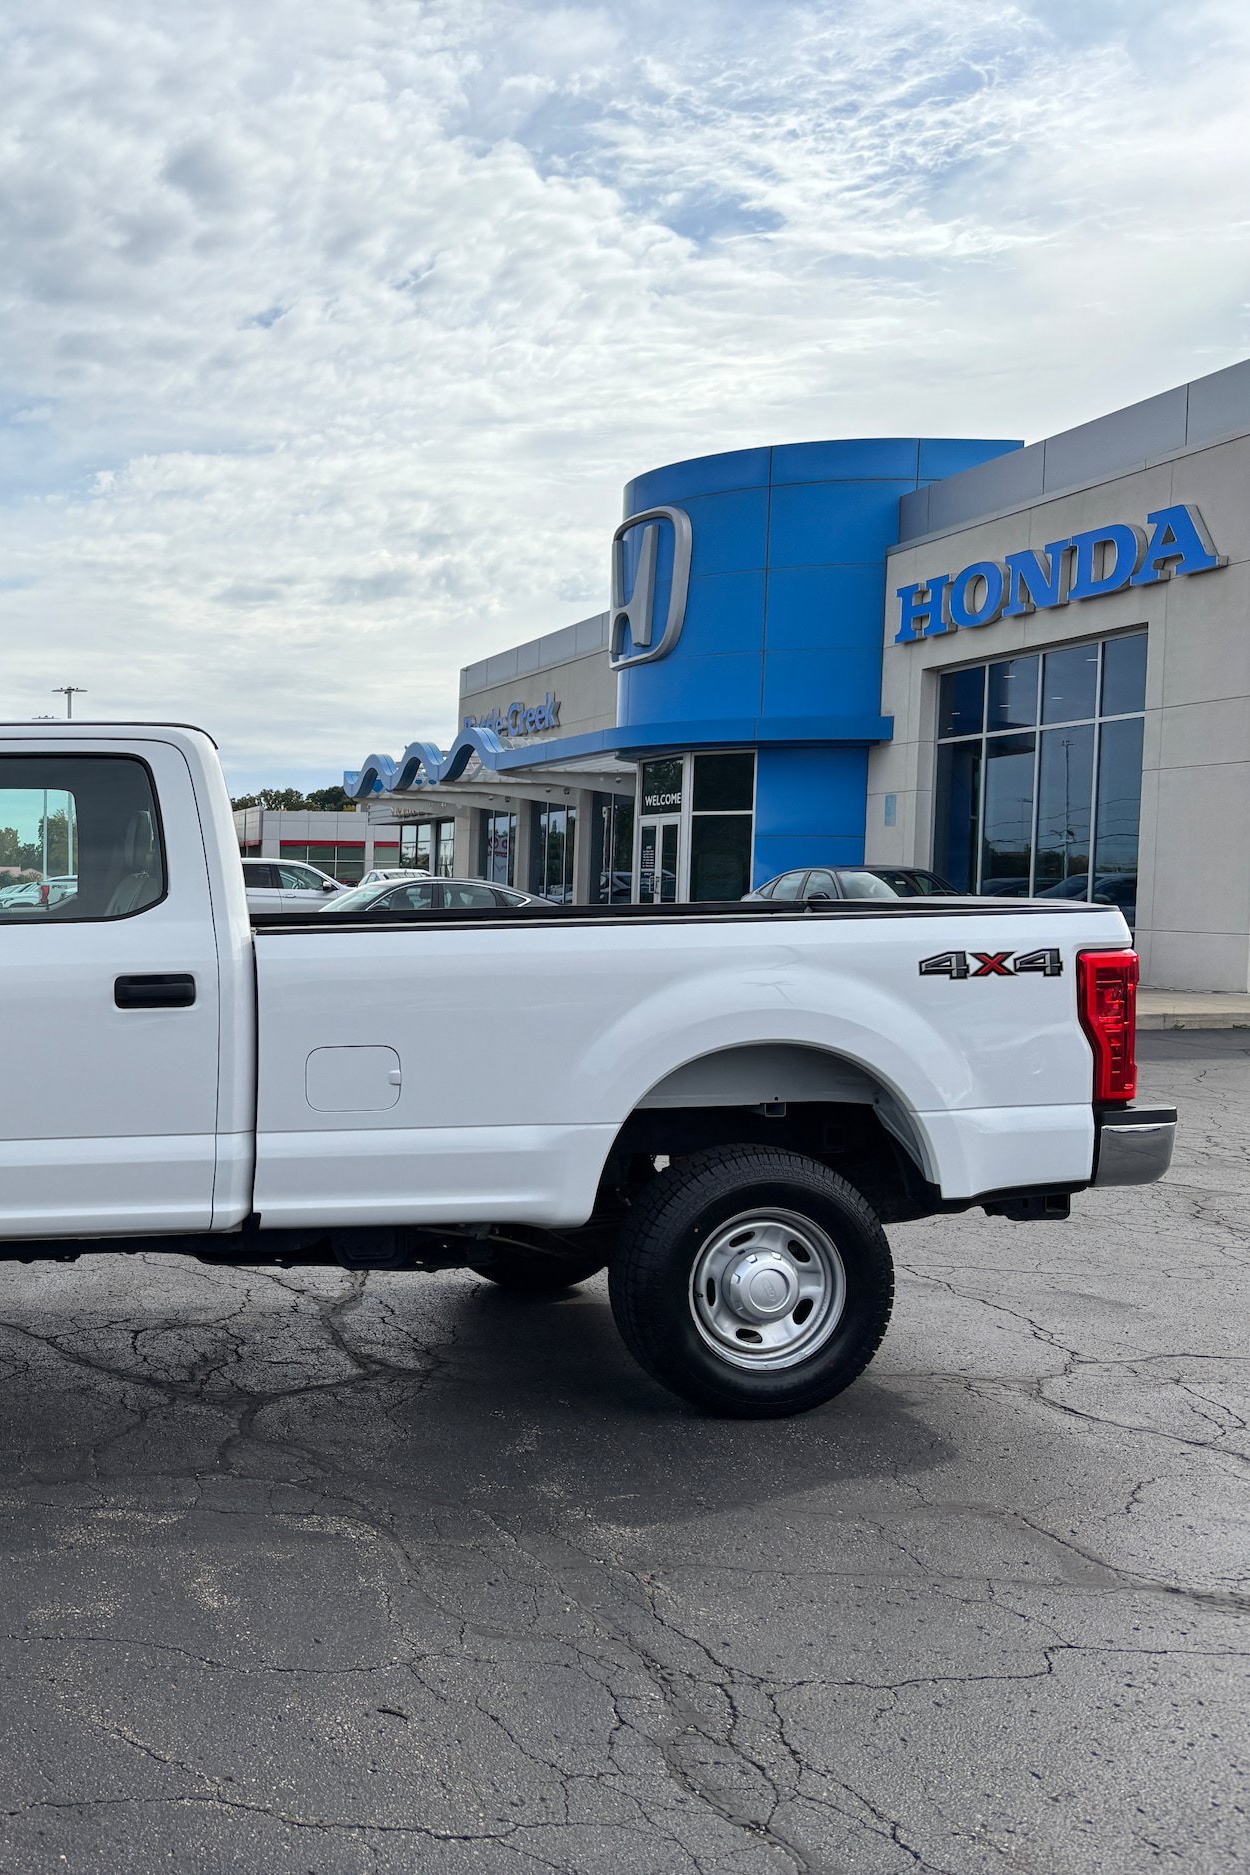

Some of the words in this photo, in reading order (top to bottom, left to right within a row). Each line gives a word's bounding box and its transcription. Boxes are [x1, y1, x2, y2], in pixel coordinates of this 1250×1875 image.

[894, 504, 1228, 643] HONDA
[507, 691, 561, 737] Creek
[645, 792, 682, 806] WELCOME
